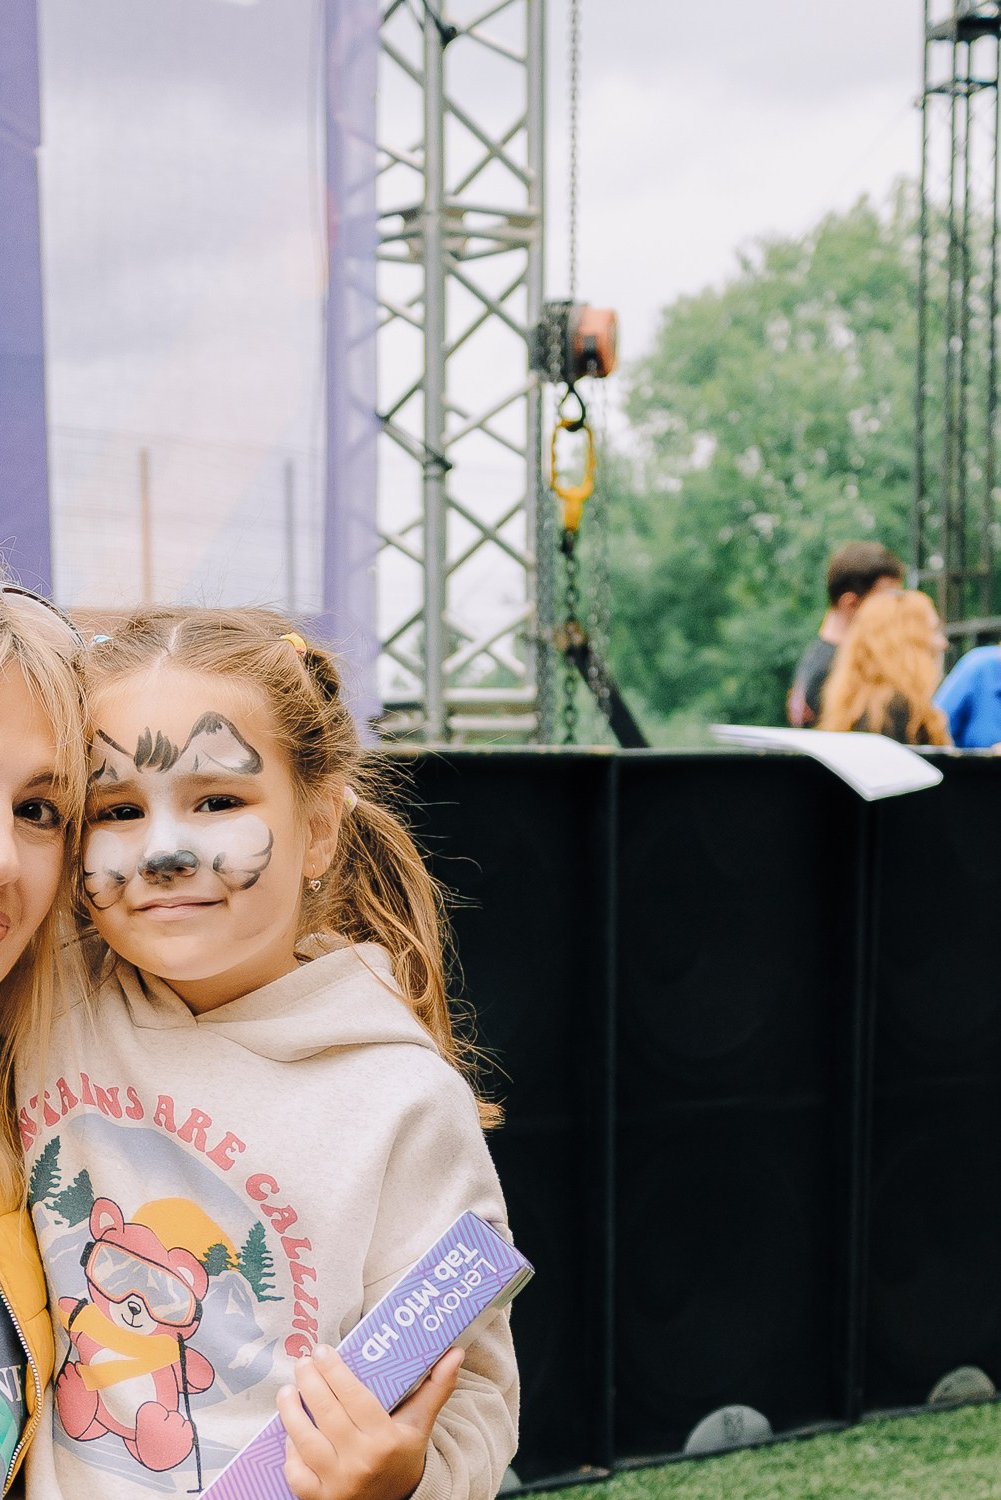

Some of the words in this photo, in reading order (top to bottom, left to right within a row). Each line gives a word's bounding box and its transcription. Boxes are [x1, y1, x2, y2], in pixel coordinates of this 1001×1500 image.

[153, 1094, 246, 1171] ARE
[245, 1172, 319, 1359] CALLING
[434, 1242, 479, 1281] Tab
[394, 1279, 440, 1327] M10
[423, 1257, 497, 1332] Lenovo
[361, 1322, 399, 1362] HD
